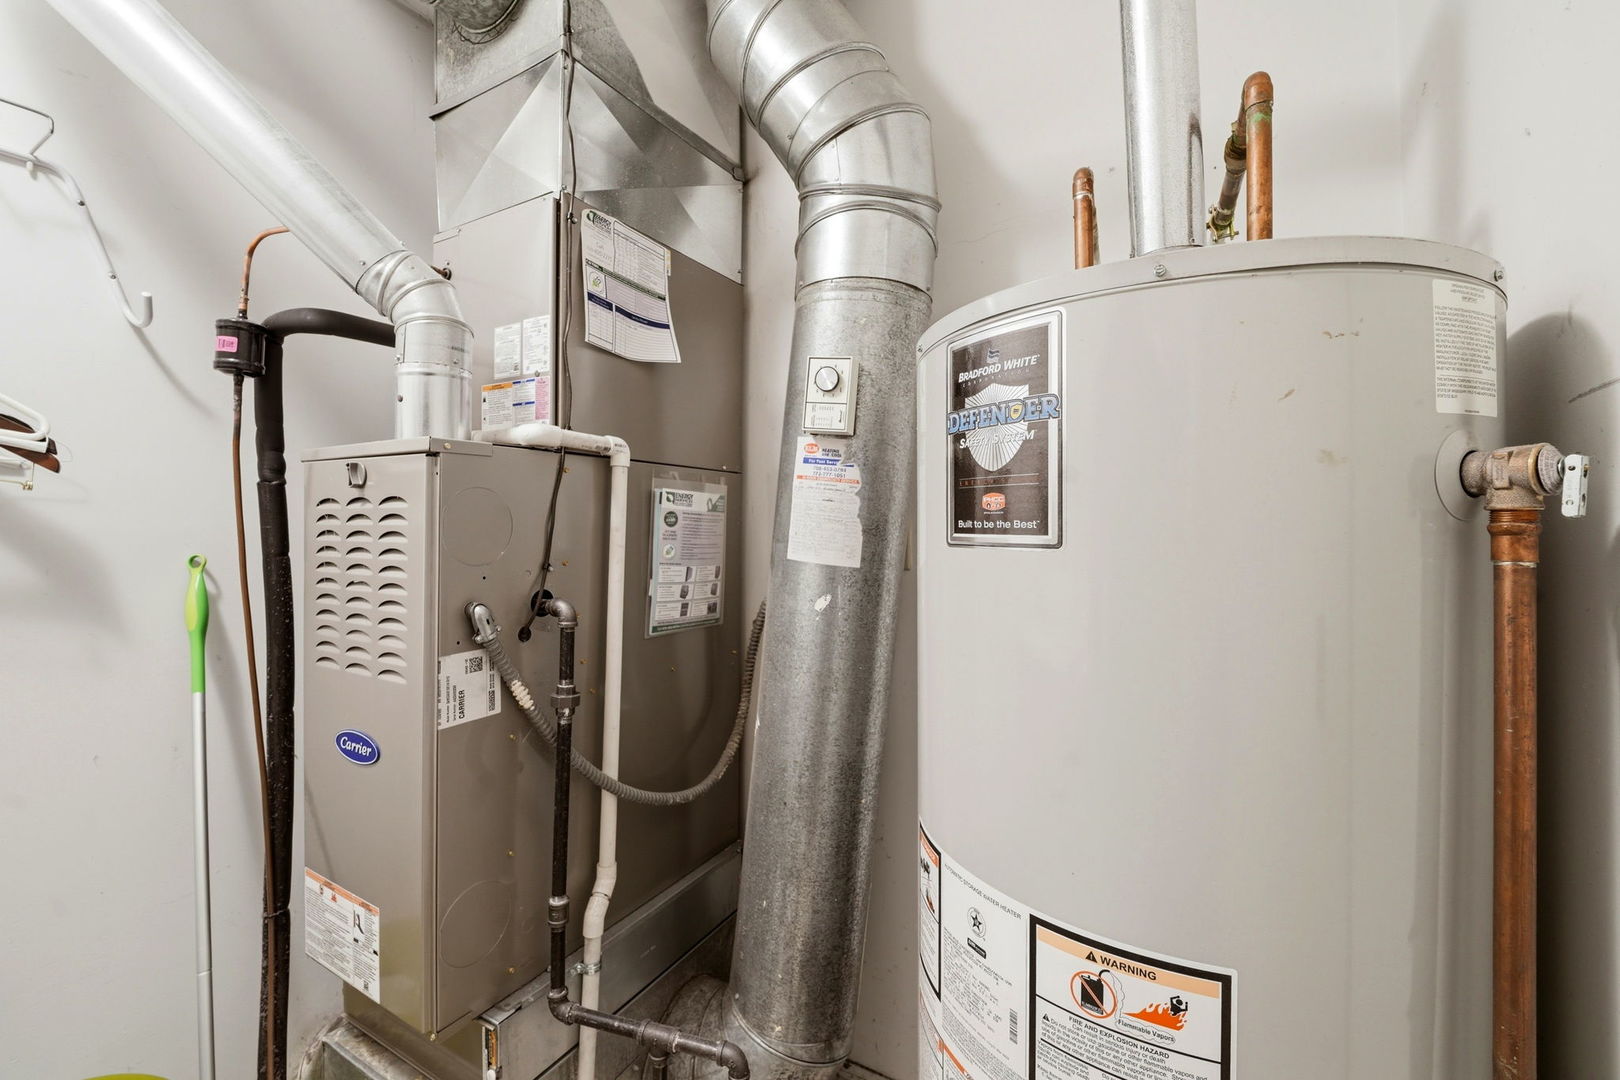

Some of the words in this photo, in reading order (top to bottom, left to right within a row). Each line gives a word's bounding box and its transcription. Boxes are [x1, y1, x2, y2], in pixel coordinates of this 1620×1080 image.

[958, 363, 1002, 384] BRADFORD
[1003, 354, 1038, 371] WHITE
[948, 394, 1060, 435] DEFENDER
[958, 520, 973, 529] Built
[974, 520, 982, 529] to
[984, 520, 994, 529] be
[996, 520, 1011, 529] the
[1013, 520, 1037, 529] Best
[458, 689, 466, 720] CARRIER
[340, 736, 372, 757] Carrier
[1000, 904, 1022, 920] HEATER
[1100, 955, 1157, 981] WARNING
[1068, 1016, 1083, 1027] FIRE
[1084, 1023, 1098, 1033] AND
[1100, 1029, 1138, 1049] EXPLOSION
[1140, 1045, 1170, 1059] HAZARD
[1118, 1019, 1152, 1035] Flammable
[1152, 1030, 1175, 1042] Vapors
